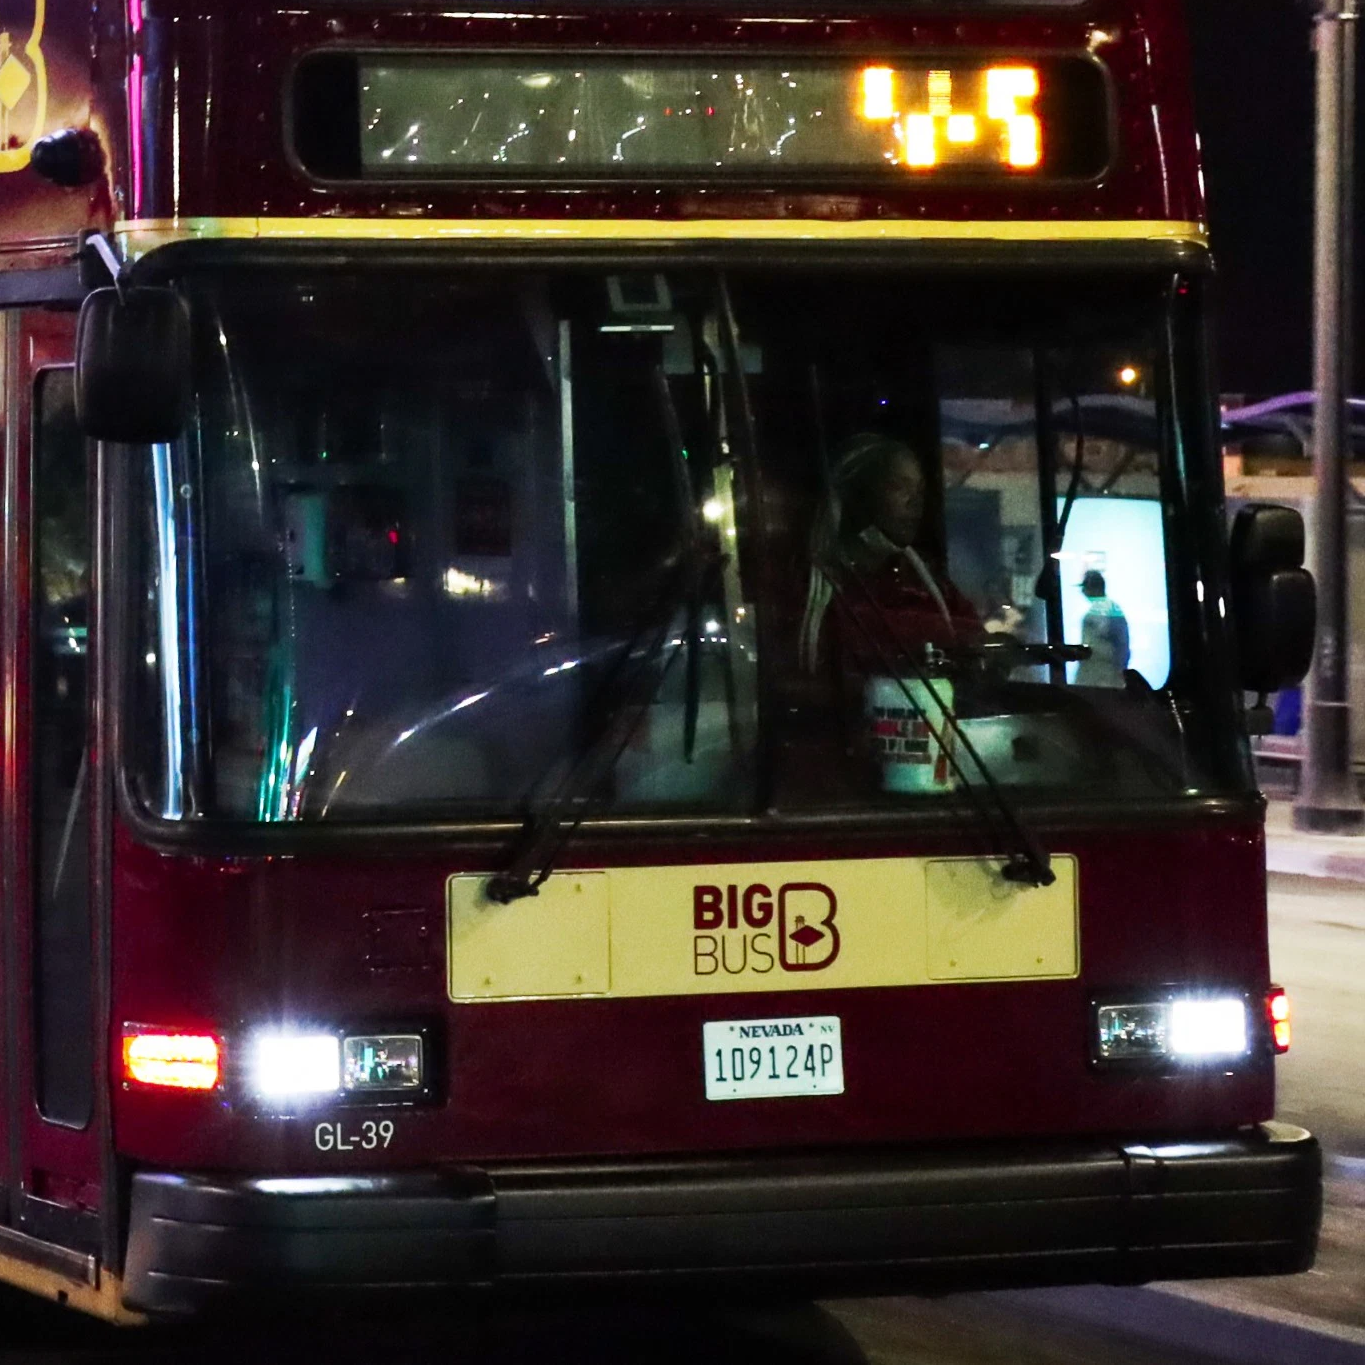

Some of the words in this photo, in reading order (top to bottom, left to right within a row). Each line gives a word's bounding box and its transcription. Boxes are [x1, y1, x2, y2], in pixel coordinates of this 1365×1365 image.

[693, 883, 774, 930] BIG
[694, 932, 775, 976] BUS
[739, 1022, 804, 1039] NEVADA
[715, 1043, 834, 1082] 109124P
[314, 1120, 395, 1151] GL-39
